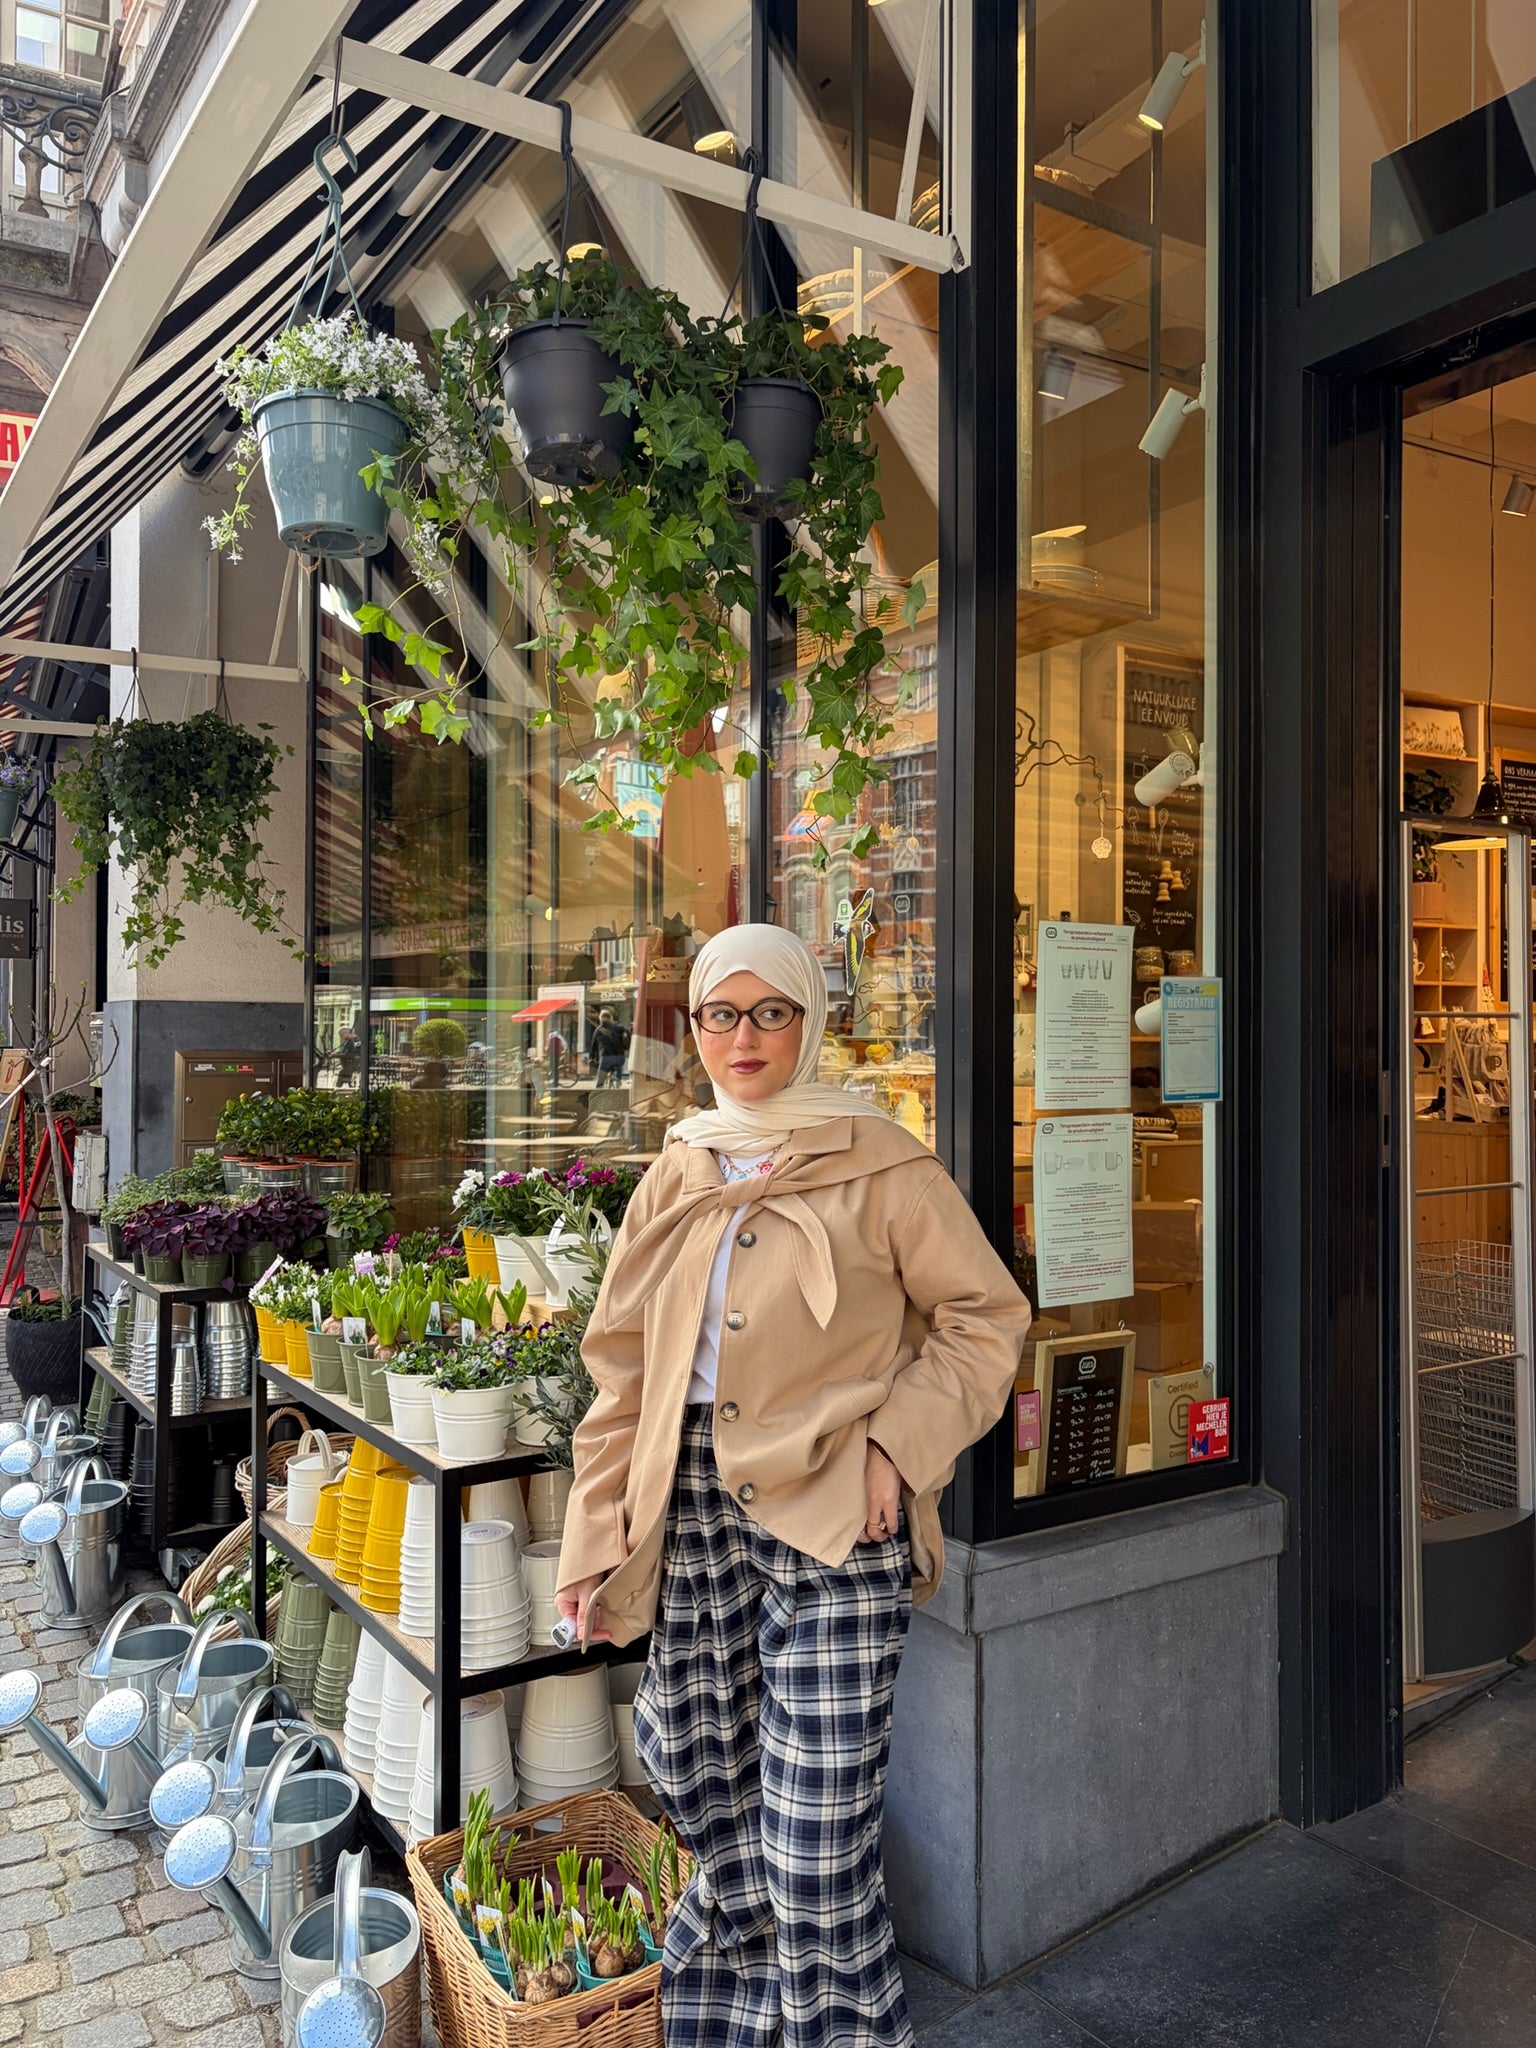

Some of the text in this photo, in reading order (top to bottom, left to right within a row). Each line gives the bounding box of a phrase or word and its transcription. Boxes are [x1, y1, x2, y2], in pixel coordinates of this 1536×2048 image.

[1141, 708, 1188, 726] EENVOUD
[1167, 997, 1215, 1008] REGISTRATIE
[1168, 1379, 1199, 1394] Certified
[1202, 1402, 1227, 1414] GEBRUIK
[1206, 1411, 1227, 1421] HIER JE
[1196, 1420, 1227, 1432] MECHELEN
[1214, 1428, 1227, 1437] BON
